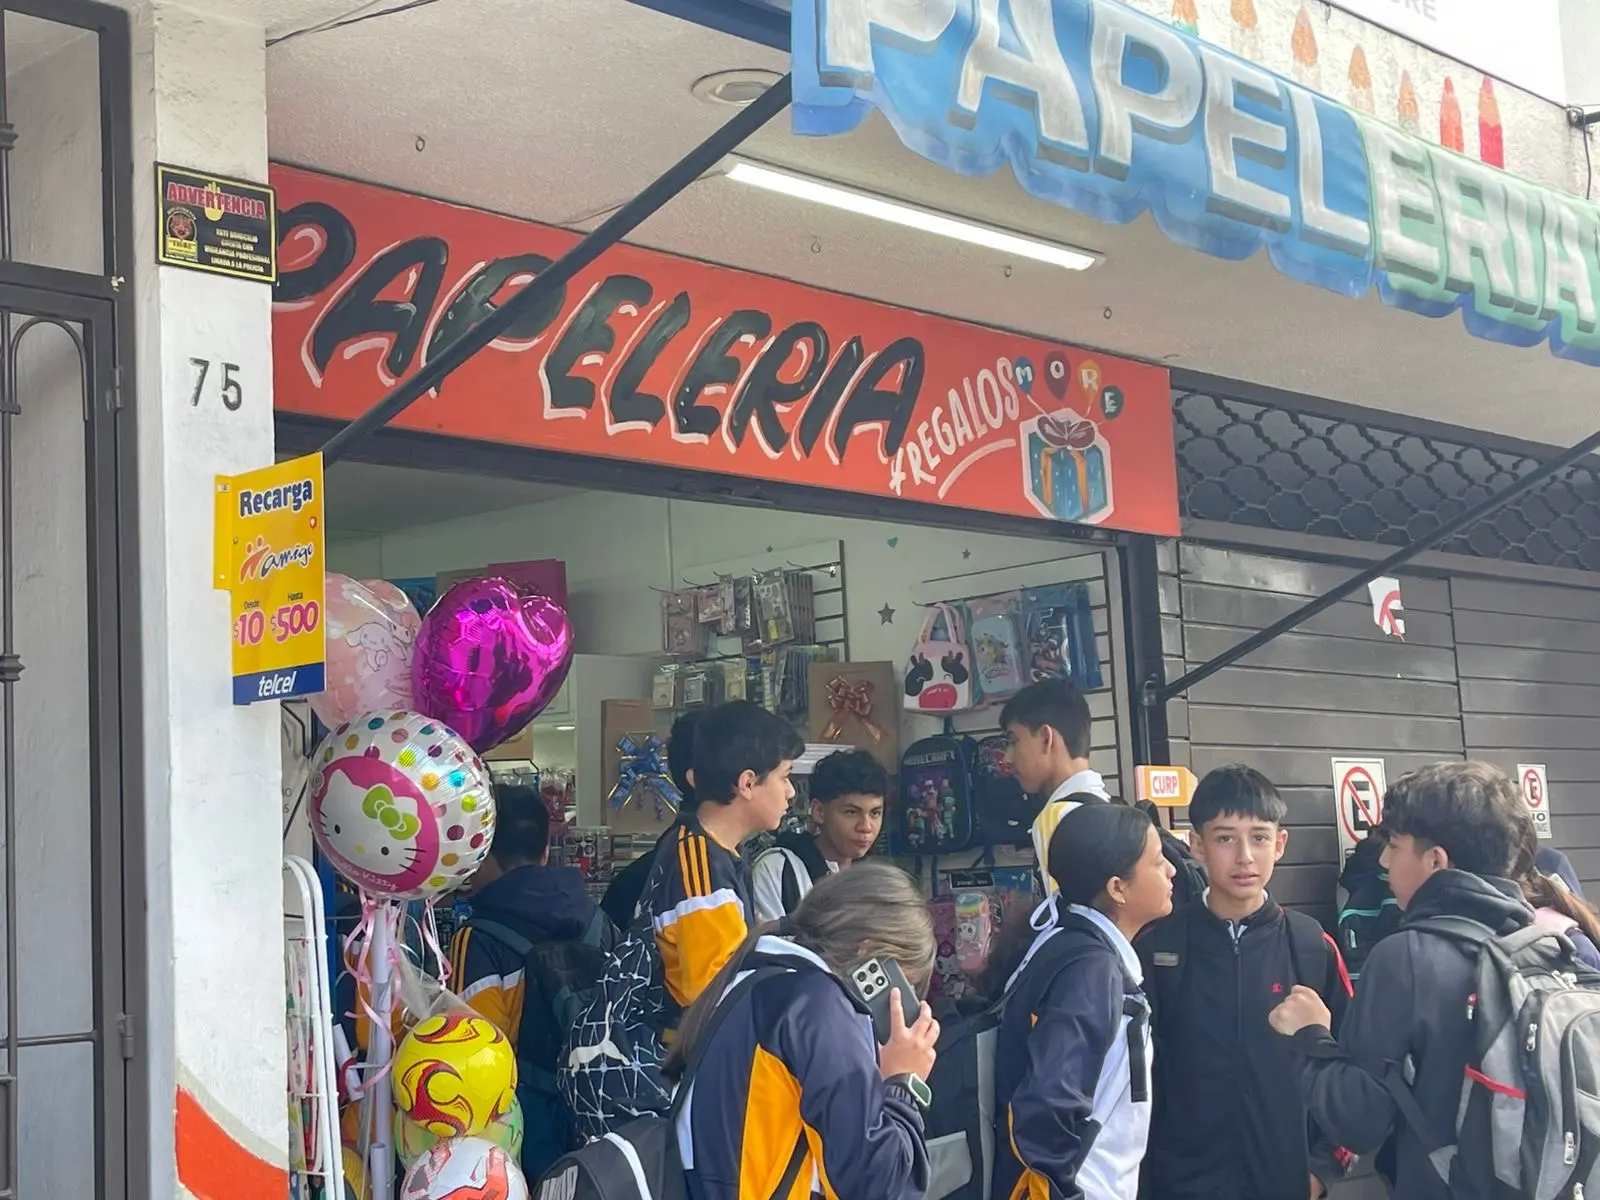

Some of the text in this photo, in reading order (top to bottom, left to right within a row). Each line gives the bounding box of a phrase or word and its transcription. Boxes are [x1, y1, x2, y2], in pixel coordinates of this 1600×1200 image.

[167, 182, 266, 220] ADVERTENCIA
[190, 358, 242, 411] 75
[239, 479, 313, 518] Recarga
[260, 543, 314, 578] amigo
[287, 591, 304, 601] Hasta
[233, 601, 320, 646] $10 $500
[258, 671, 297, 697] telcel
[1153, 775, 1178, 794] CURP
